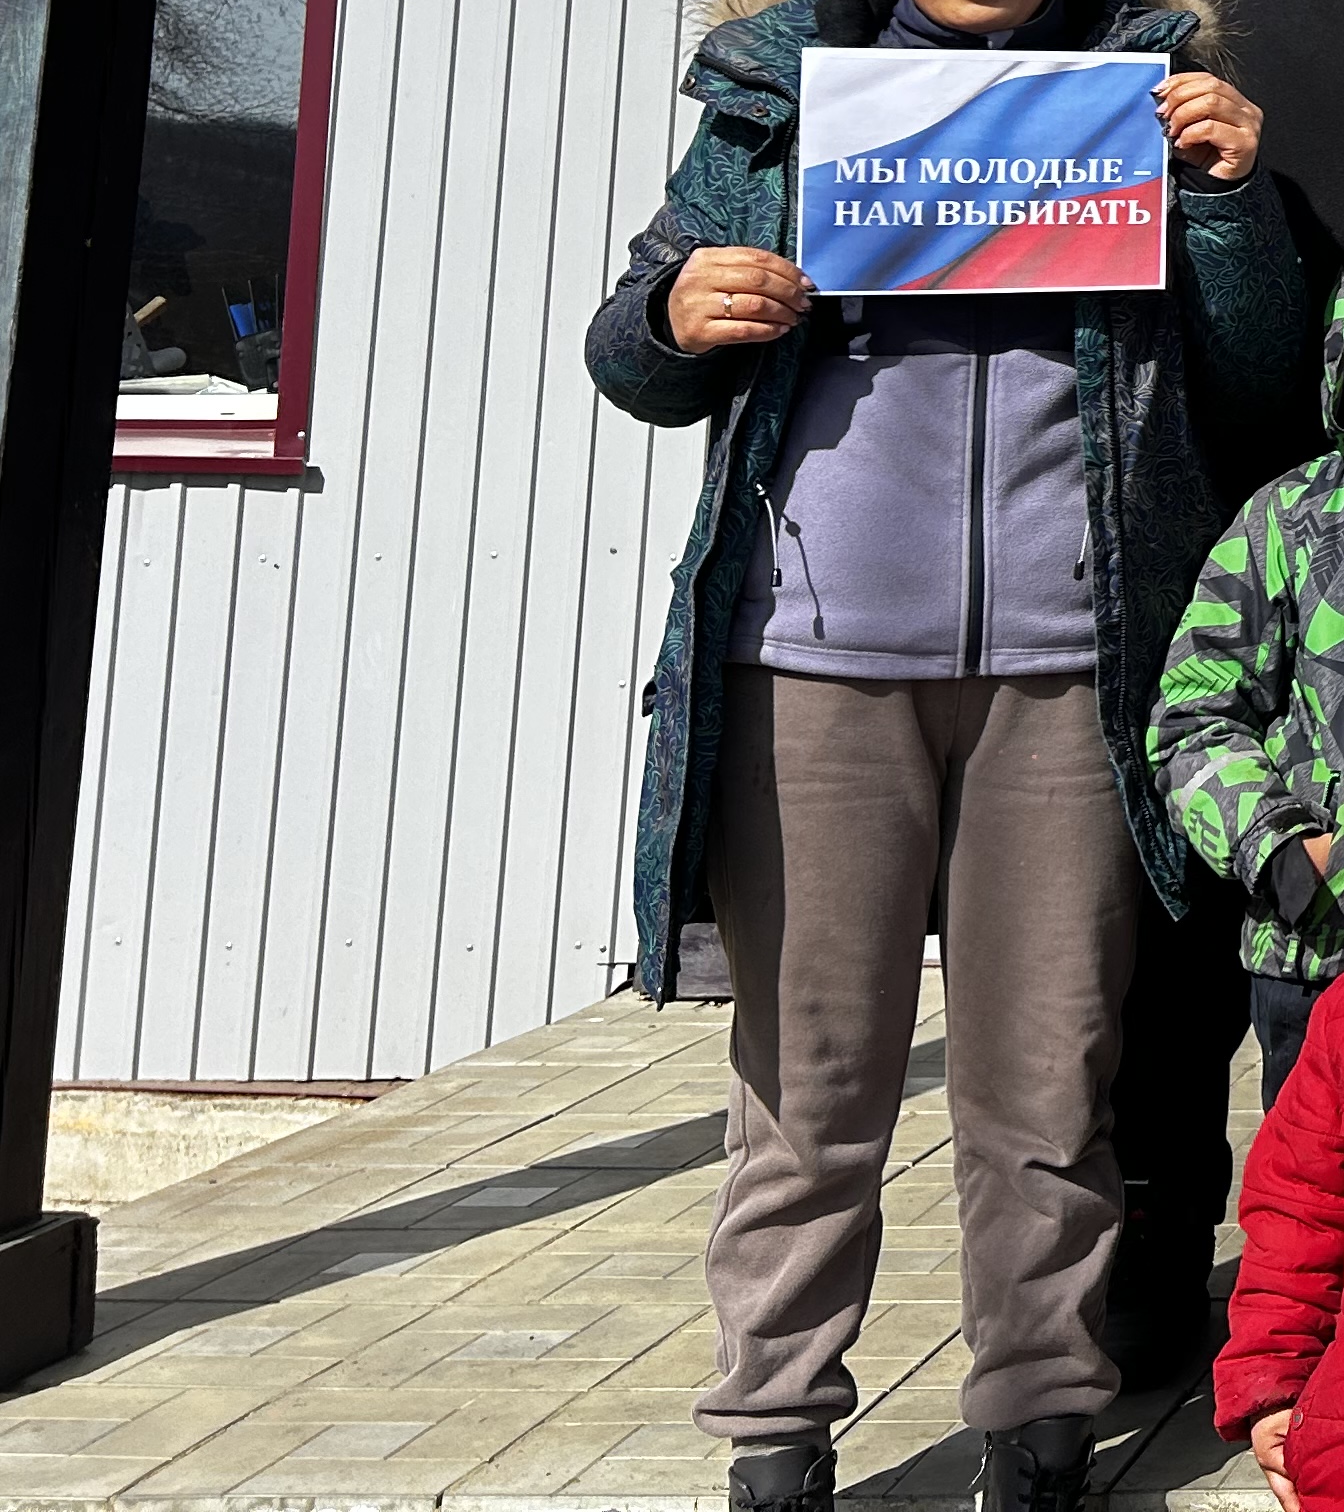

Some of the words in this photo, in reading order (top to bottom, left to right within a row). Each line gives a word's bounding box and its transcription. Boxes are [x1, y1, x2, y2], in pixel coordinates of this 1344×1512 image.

[834, 157, 906, 184] МЫ
[917, 157, 1123, 189] МОЛОДЫЕ
[834, 200, 924, 227] НАМ
[935, 199, 1152, 227] ВЫБИРАТЬ
